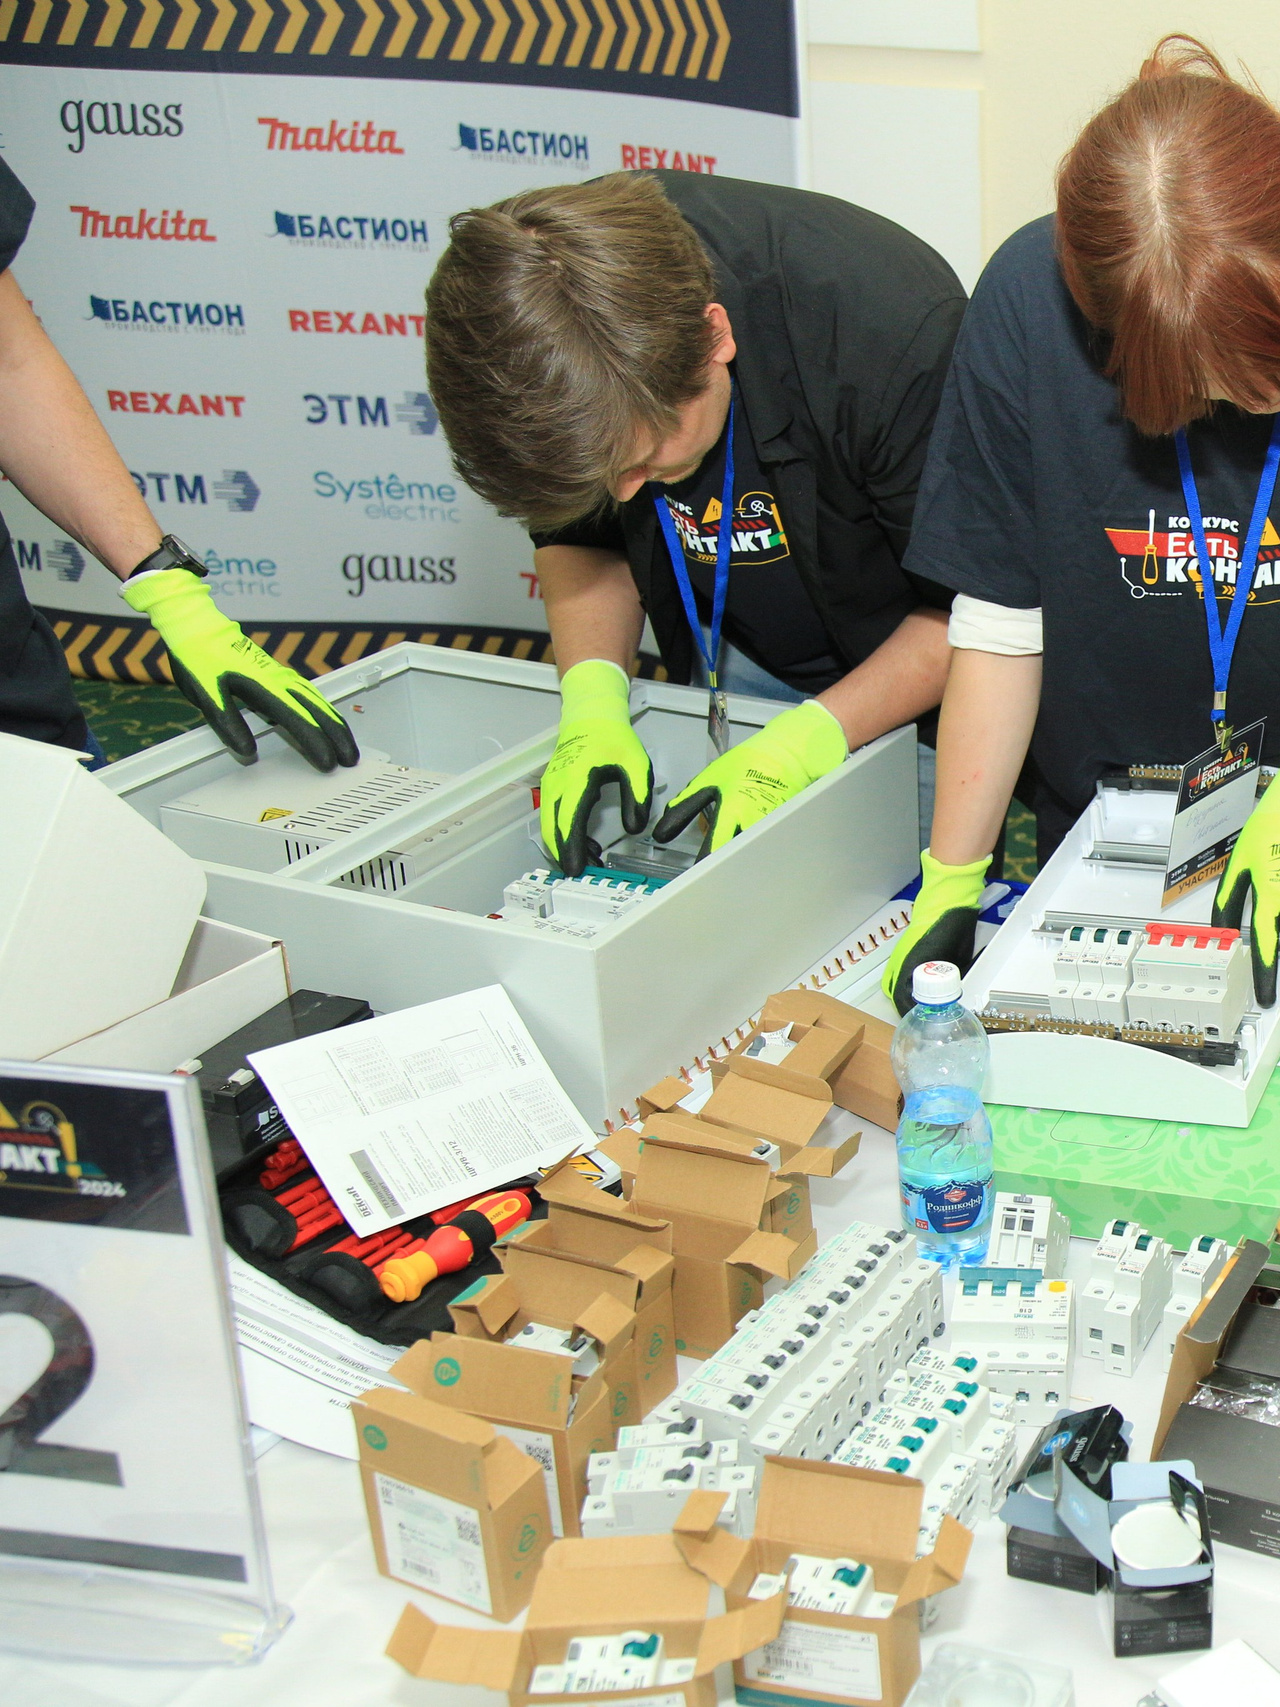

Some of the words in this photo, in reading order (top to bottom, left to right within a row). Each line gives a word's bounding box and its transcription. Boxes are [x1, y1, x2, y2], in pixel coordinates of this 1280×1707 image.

[60, 99, 184, 154] gauss
[258, 117, 404, 155] makita
[479, 127, 589, 161] БАСТИОН
[621, 144, 717, 175] REXANT
[70, 205, 217, 242] makita
[297, 215, 428, 243] БАСТИОН
[112, 300, 244, 327] БАСТИОН
[288, 310, 425, 337] REXANT
[107, 390, 246, 418] REXANT
[304, 394, 390, 427] ЭТМ
[314, 470, 457, 503] Systême
[365, 502, 461, 524] electric
[1168, 516, 1239, 533] КОКУРС
[342, 554, 457, 598] gauss
[1200, 761, 1243, 790] КОНТАКТ
[1243, 761, 1257, 771] 2024
[78, 1178, 127, 1198] 2024
[346, 1186, 371, 1216] DEKraft
[927, 1195, 982, 1212] Родникофф
[232, 1315, 286, 1344] самостоятель
[287, 1352, 314, 1370] строго
[336, 1353, 370, 1372] ЗАДАНИЕ
[1069, 1437, 1088, 1461] gauss
